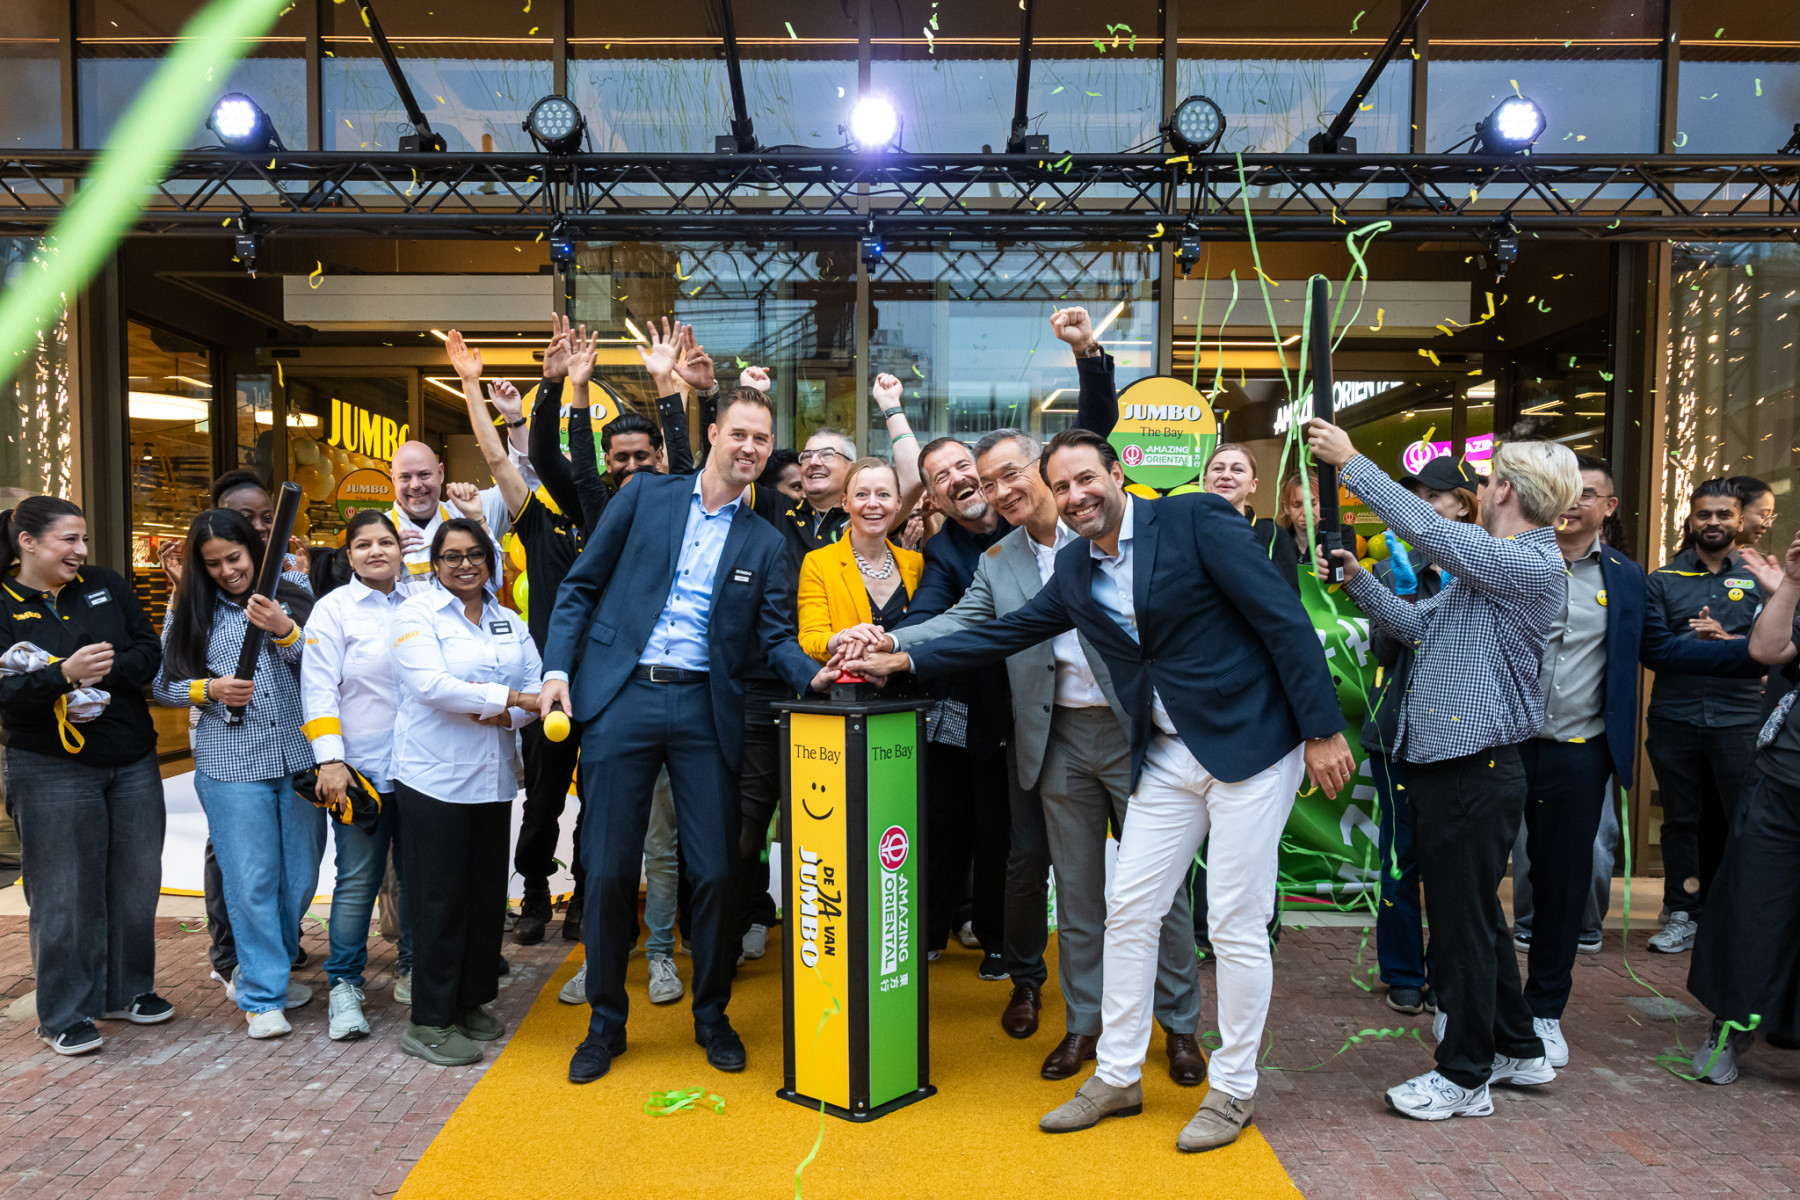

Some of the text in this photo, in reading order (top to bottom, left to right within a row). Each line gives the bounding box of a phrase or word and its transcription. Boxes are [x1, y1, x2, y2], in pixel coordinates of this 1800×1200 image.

[1123, 404, 1202, 421] JUMBO
[1140, 427, 1183, 439] The Bay
[1145, 445, 1189, 453] AMAZING
[346, 484, 389, 494] JUMBO
[794, 744, 841, 765] The Bay
[872, 744, 913, 761] The Bay
[823, 866, 834, 886] DE
[799, 845, 819, 968] JUMBO
[885, 877, 895, 969] ORIENTAL
[898, 873, 909, 963] AMAZING
[823, 926, 835, 957] VAN
